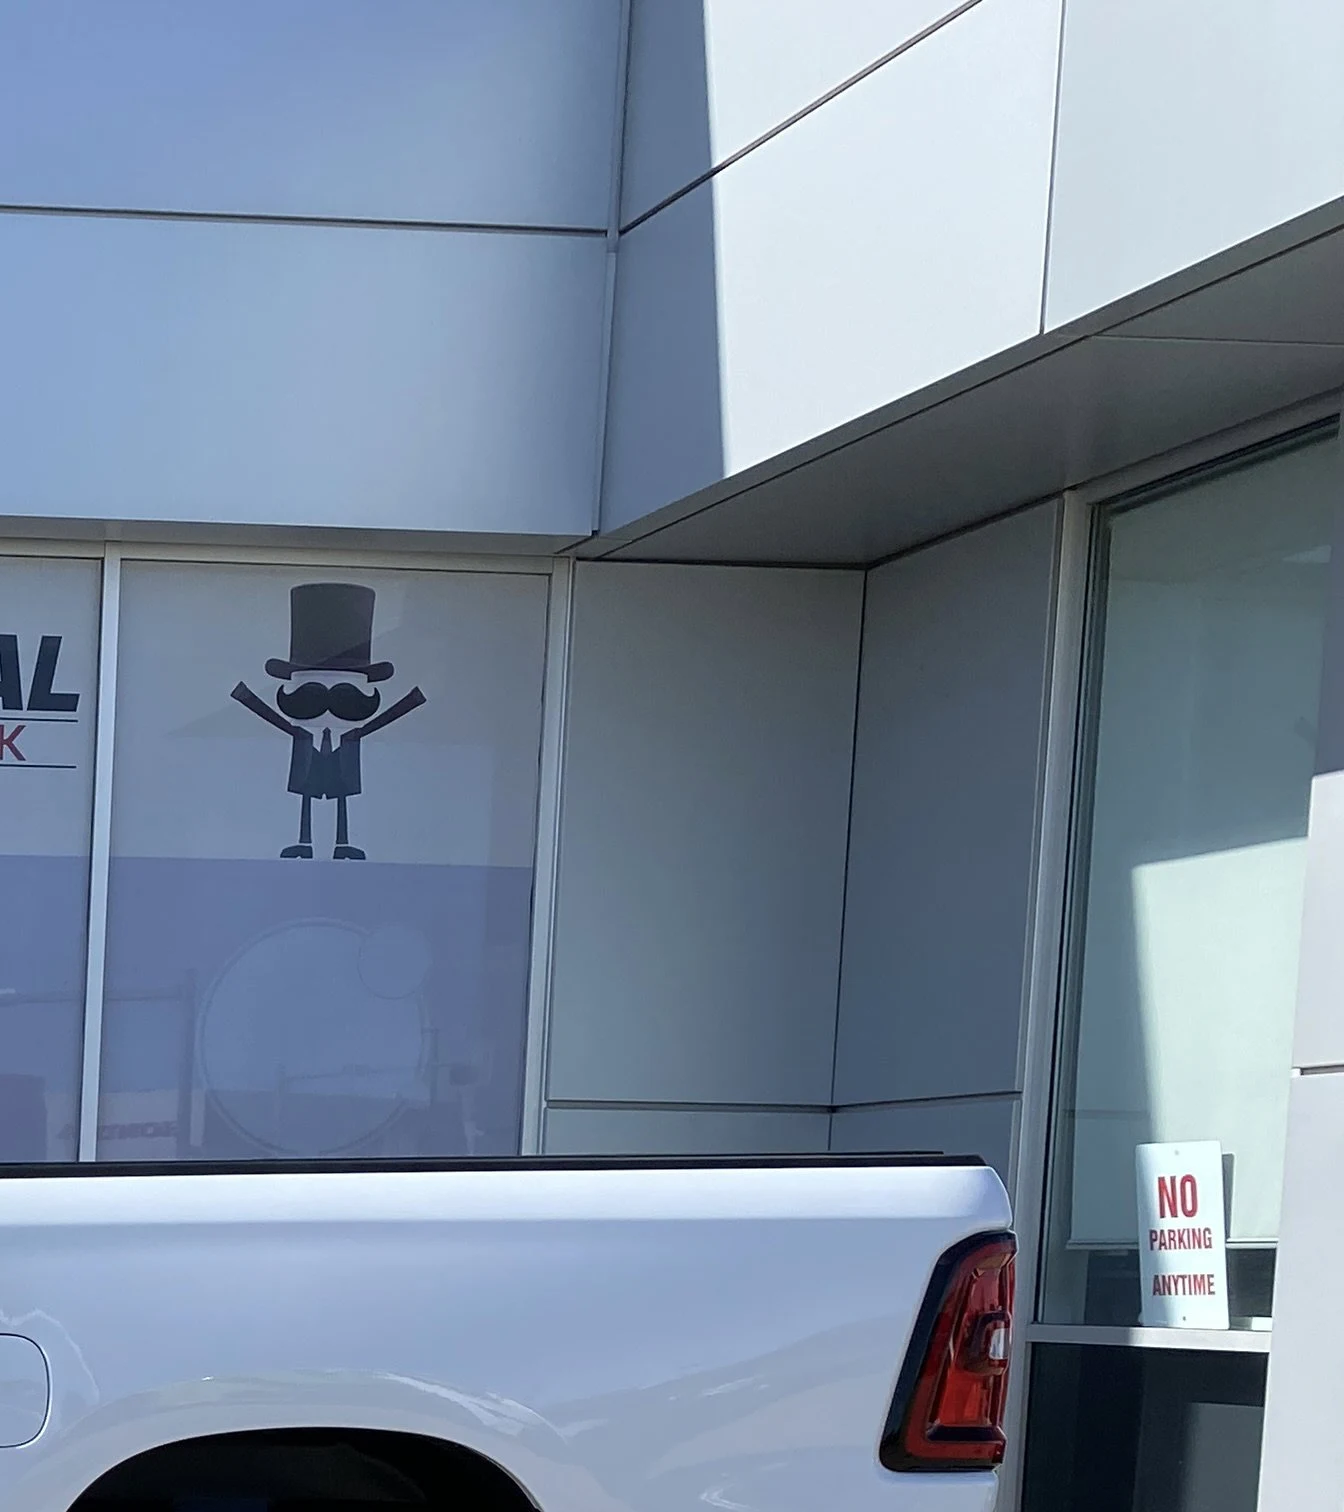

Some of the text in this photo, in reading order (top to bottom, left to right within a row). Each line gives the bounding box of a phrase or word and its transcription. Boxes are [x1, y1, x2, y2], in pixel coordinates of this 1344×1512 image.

[1157, 1174, 1198, 1218] NO
[1149, 1227, 1213, 1250] PARKING
[1152, 1274, 1215, 1296] ANYTIME
